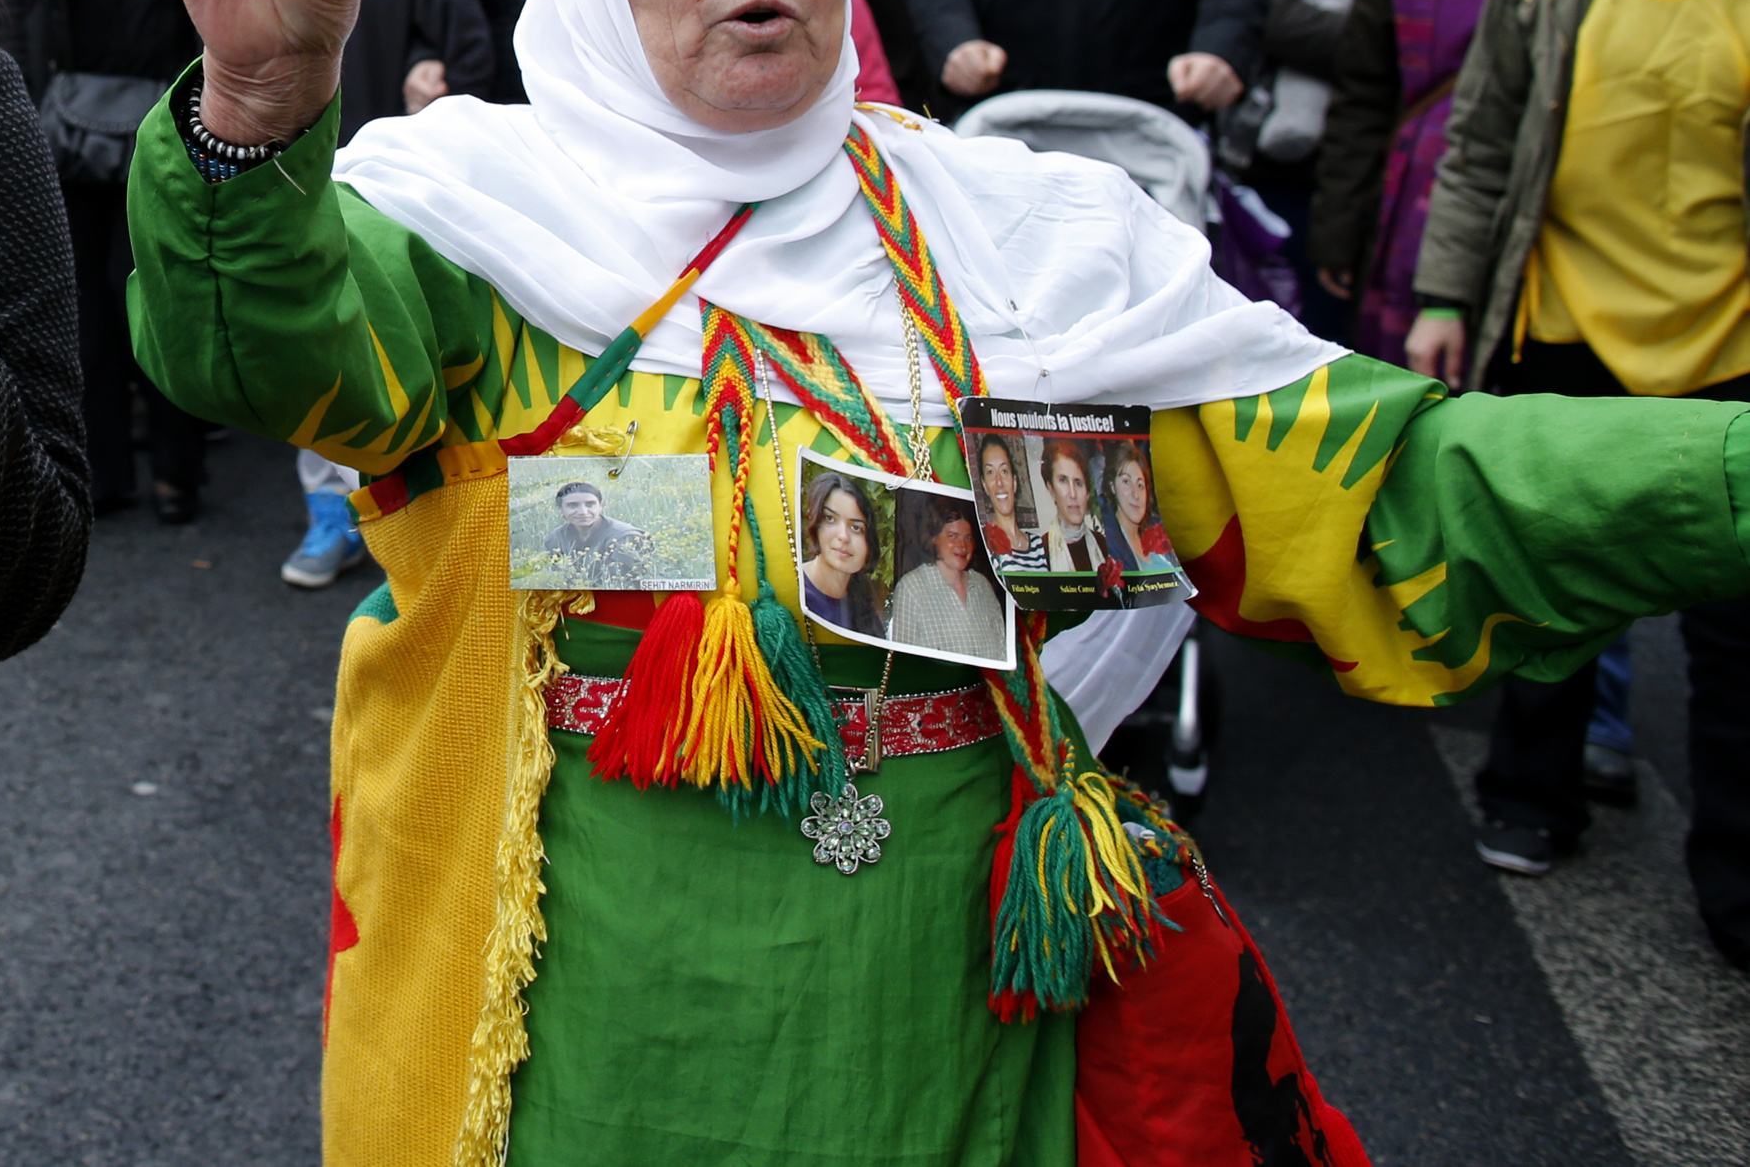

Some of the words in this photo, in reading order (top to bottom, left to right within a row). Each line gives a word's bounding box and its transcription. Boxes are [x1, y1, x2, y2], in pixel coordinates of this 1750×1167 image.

[991, 409, 1017, 427] Nous
[1017, 412, 1057, 431] voulons
[1057, 413, 1070, 431] la
[1069, 414, 1115, 433] justice!
